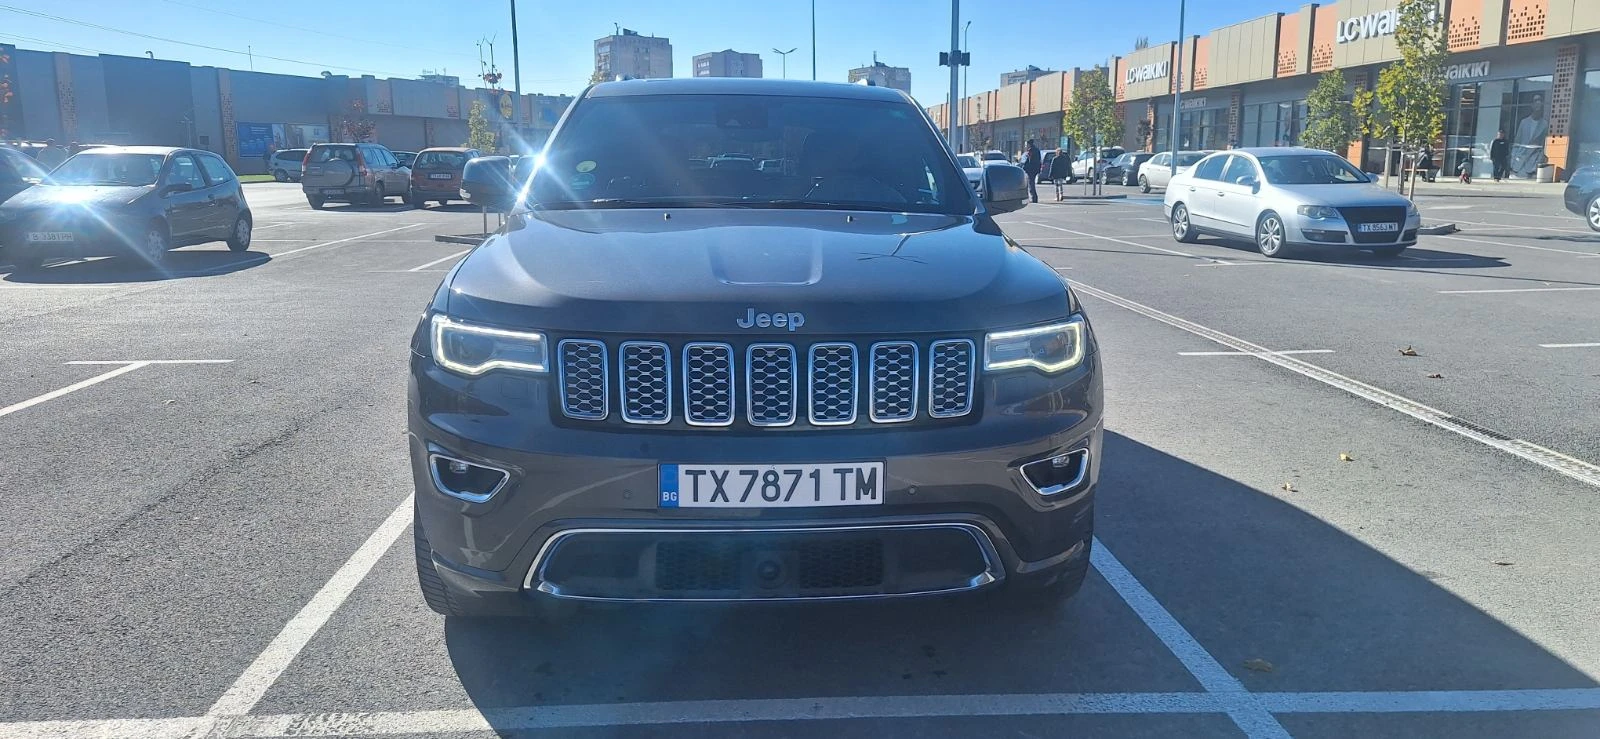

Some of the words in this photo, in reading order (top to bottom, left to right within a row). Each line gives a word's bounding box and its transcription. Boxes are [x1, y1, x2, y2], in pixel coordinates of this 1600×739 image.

[736, 307, 805, 332] Jeep
[663, 492, 677, 502] BG
[685, 470, 730, 502] TX
[739, 468, 821, 502] 7871
[833, 467, 877, 500] TM
